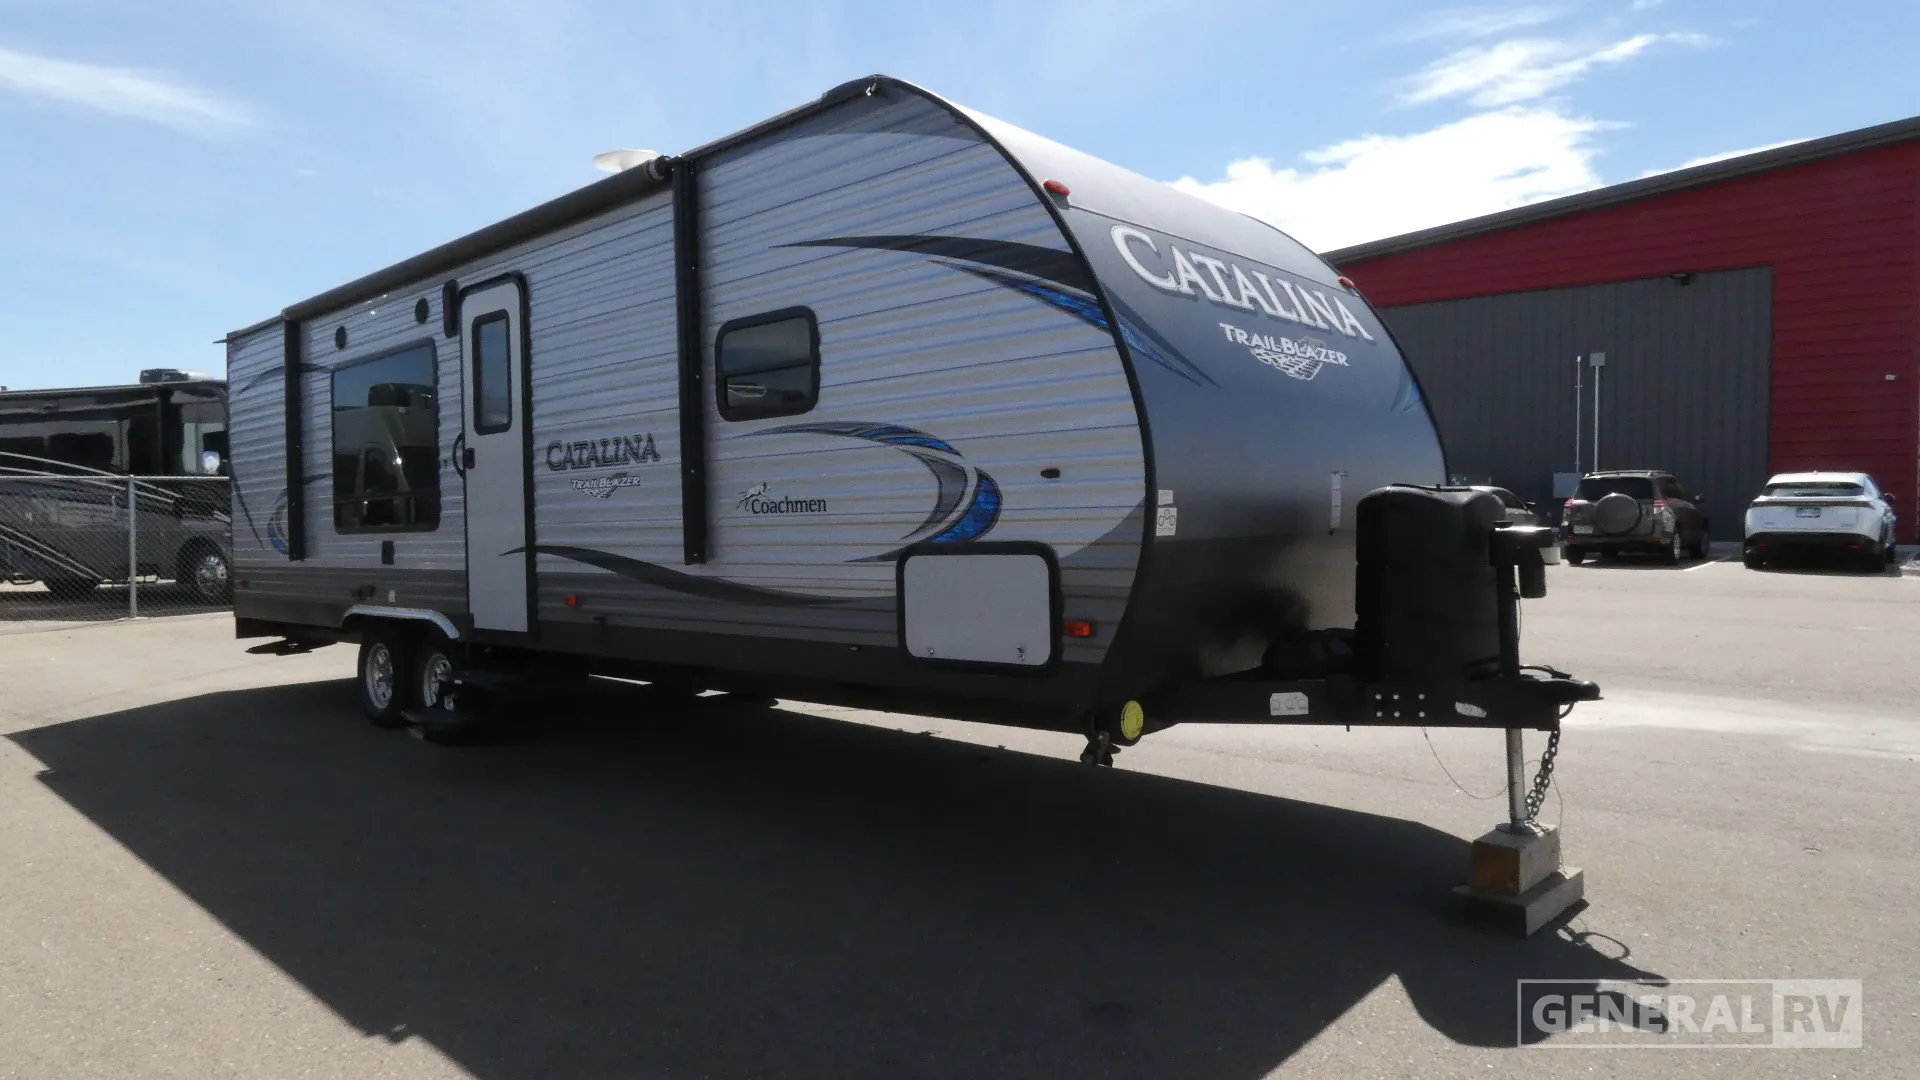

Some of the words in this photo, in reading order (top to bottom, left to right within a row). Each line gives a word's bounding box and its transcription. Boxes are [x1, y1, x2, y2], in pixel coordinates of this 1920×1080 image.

[1110, 224, 1376, 343] CATALINA
[546, 432, 661, 471] CATALINA
[752, 496, 827, 514] Coachmen
